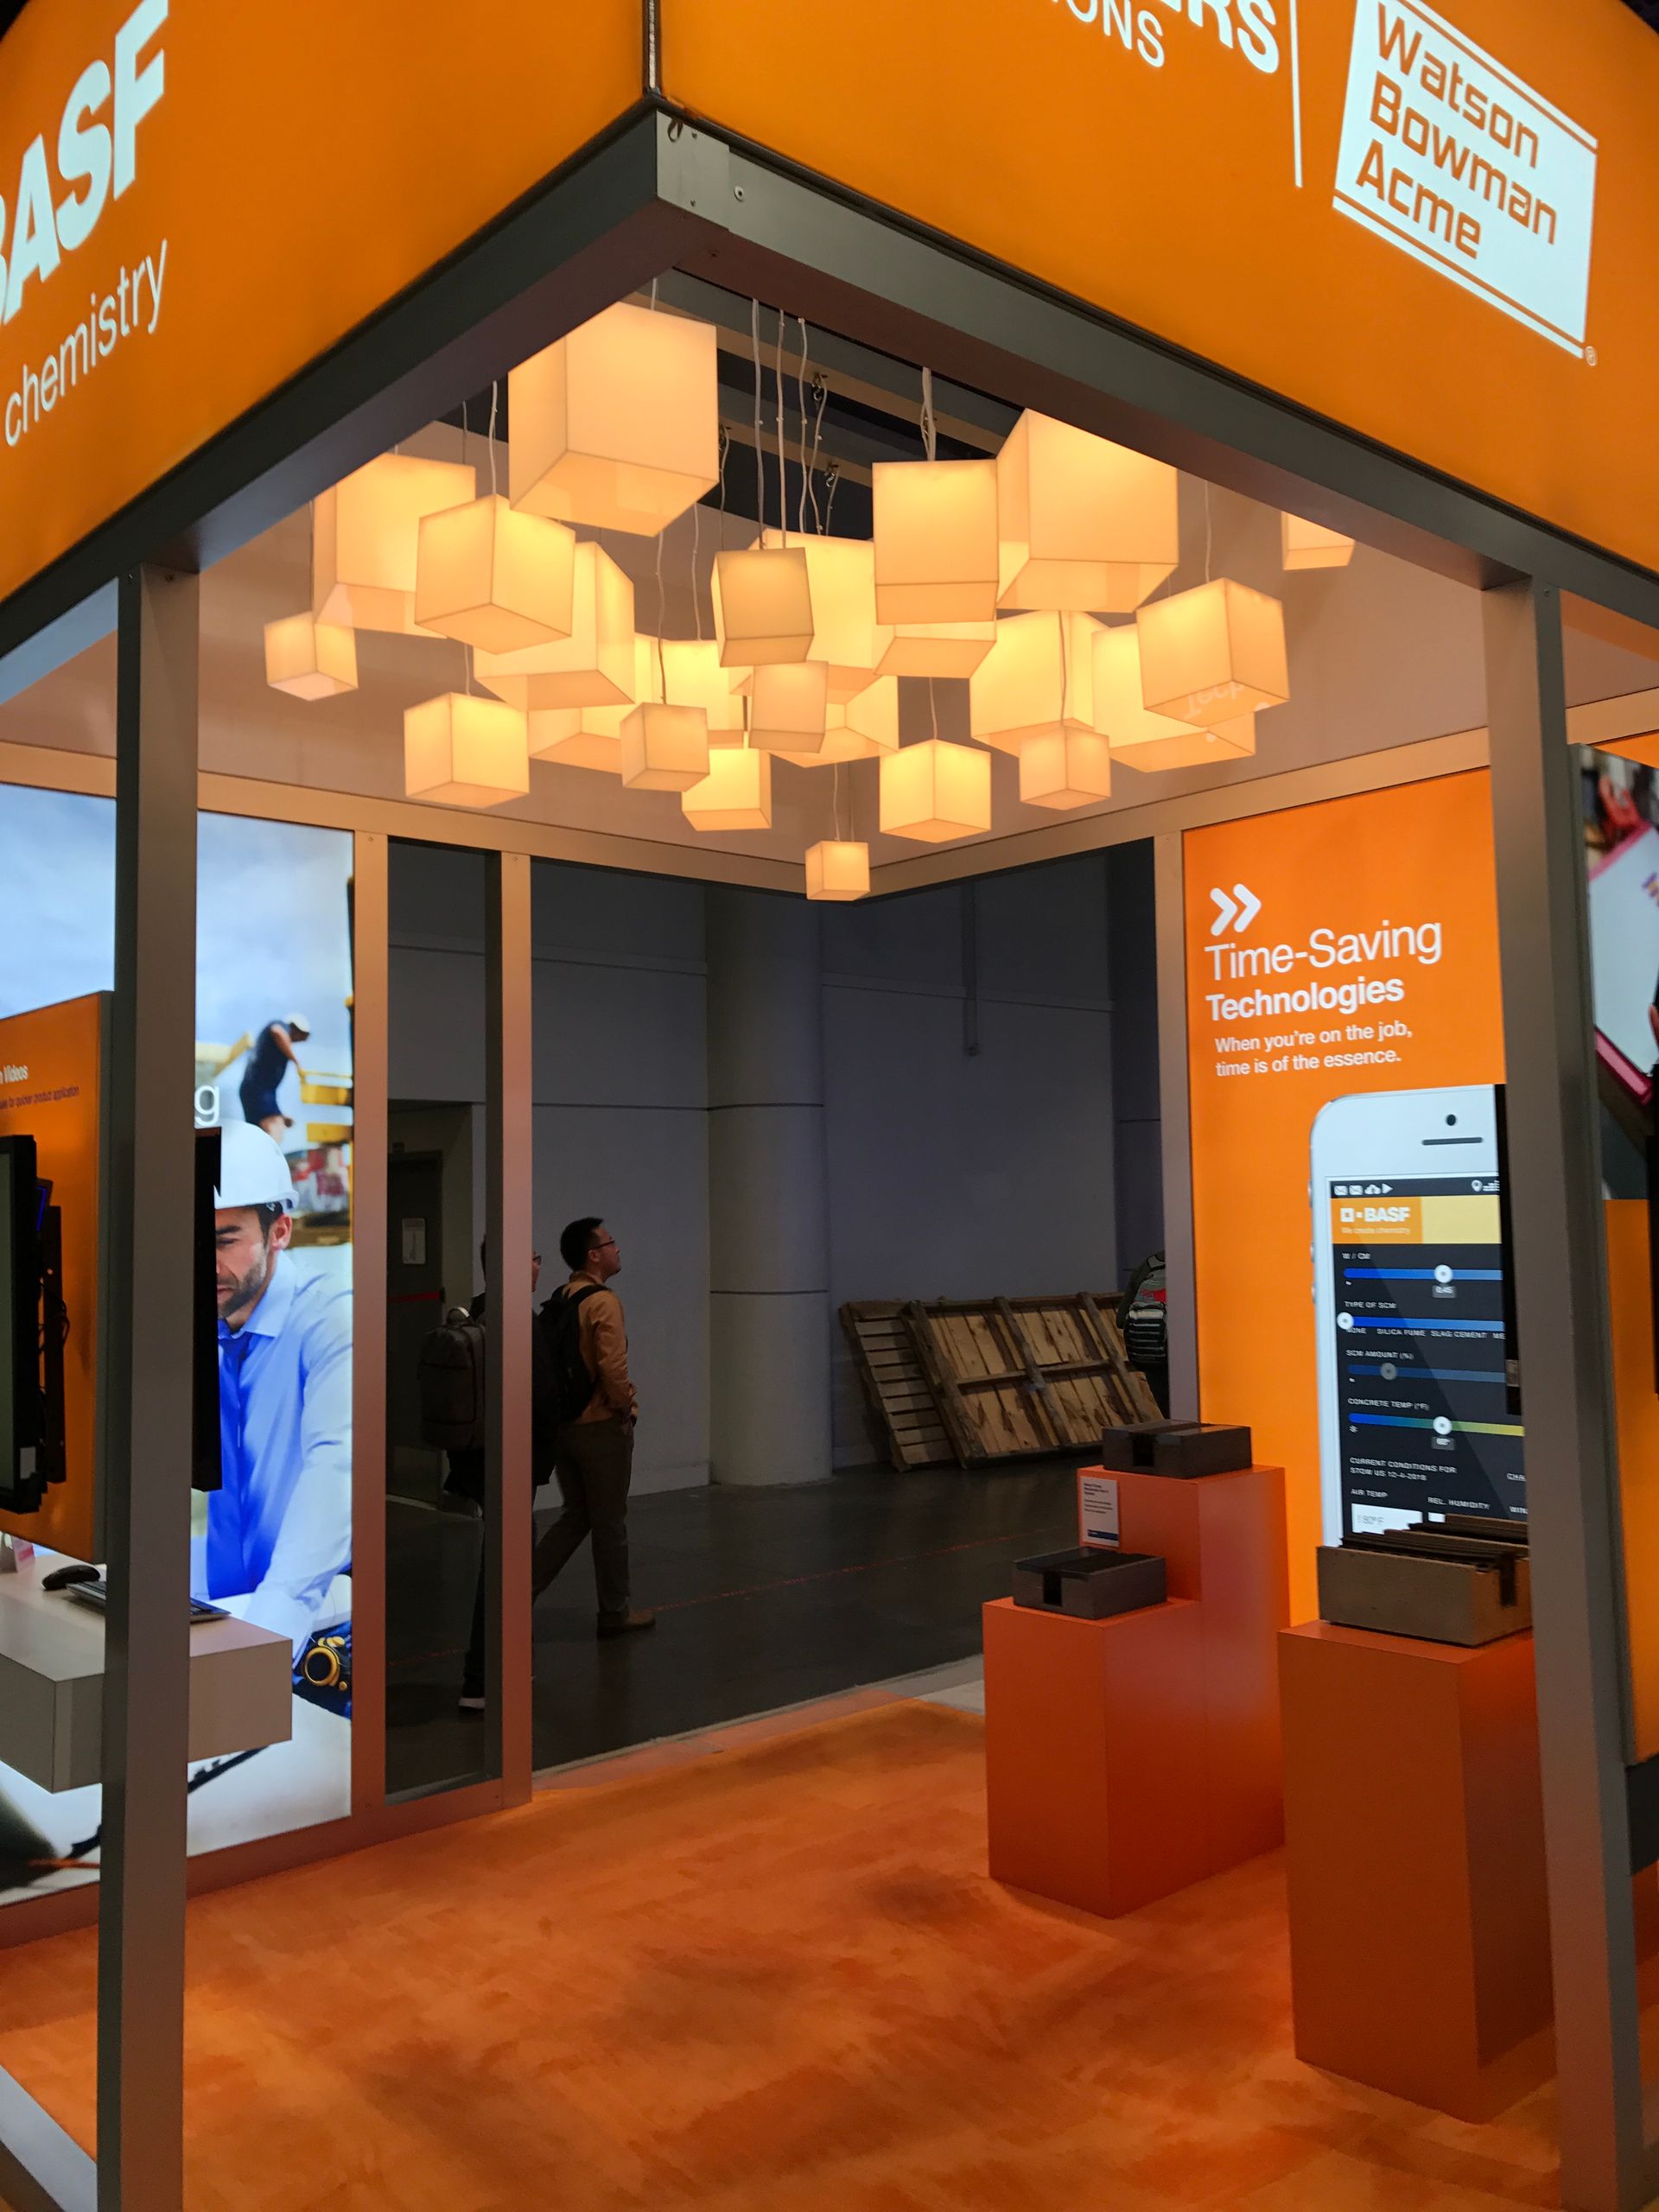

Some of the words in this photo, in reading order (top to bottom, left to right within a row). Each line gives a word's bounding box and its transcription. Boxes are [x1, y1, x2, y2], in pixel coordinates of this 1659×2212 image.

[1378, 2, 1539, 168] Watson
[0, 0, 168, 325] ASF
[1370, 70, 1557, 245] Bowman
[1356, 138, 1481, 260] Acme
[5, 238, 168, 447] chemistry
[1205, 919, 1442, 982] Time-Saving
[1205, 976, 1405, 1021] Technologies
[1215, 1036, 1261, 1053] When
[1264, 1029, 1315, 1052] you're
[1319, 1028, 1341, 1043] on
[1346, 1024, 1374, 1040] the
[1377, 1020, 1413, 1042] job,
[1215, 1061, 1250, 1077] time
[1254, 1059, 1268, 1074] is
[1272, 1056, 1289, 1072] of
[1293, 1054, 1320, 1071] the
[1323, 1048, 1402, 1069] essence.
[1363, 1206, 1411, 1222] BASF
[1347, 1397, 1390, 1408] CONCRETE
[1349, 1457, 1387, 1467] CURRENT
